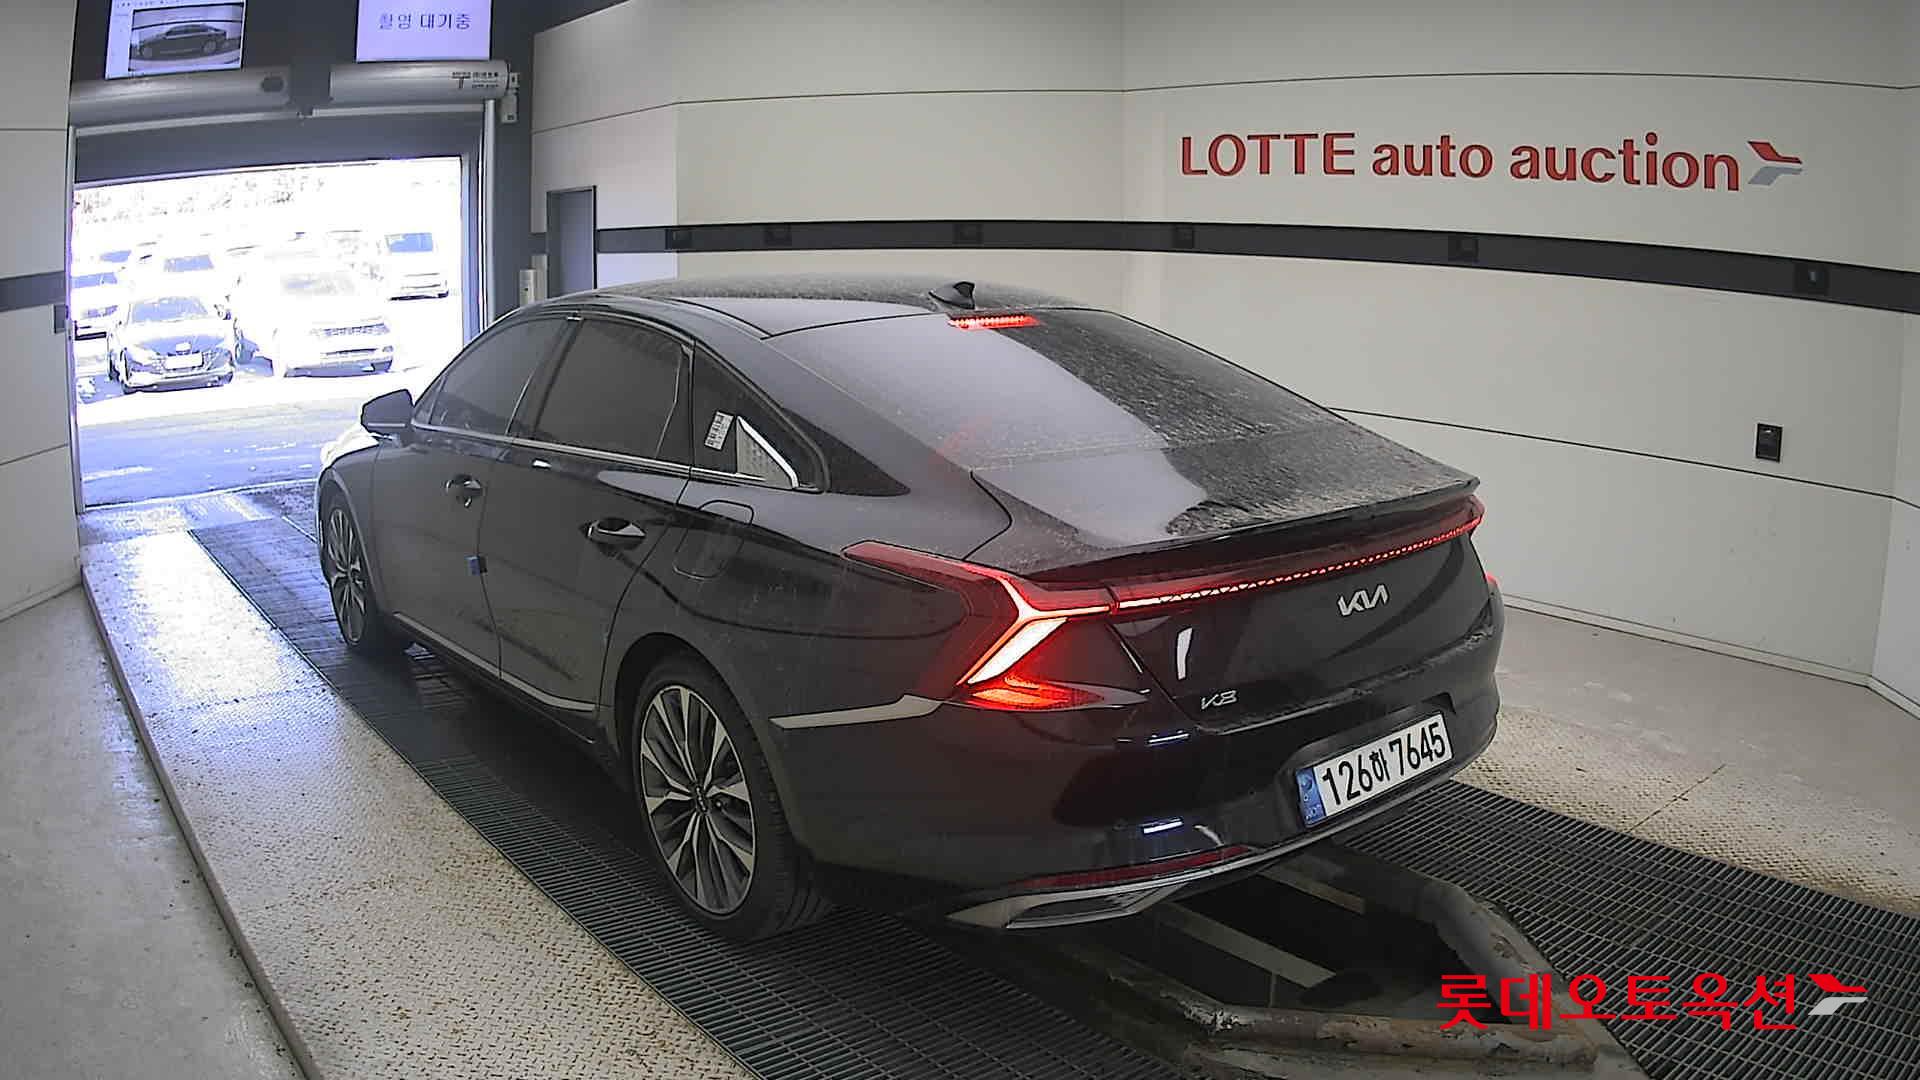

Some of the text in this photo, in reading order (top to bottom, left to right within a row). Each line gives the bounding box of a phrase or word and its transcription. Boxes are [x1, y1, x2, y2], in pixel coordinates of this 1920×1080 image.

[420, 13, 473, 30] 대기중
[1180, 131, 1740, 192] LOTTE auto auction
[1200, 689, 1238, 710] K8
[1322, 721, 1447, 805] 126하 7645
